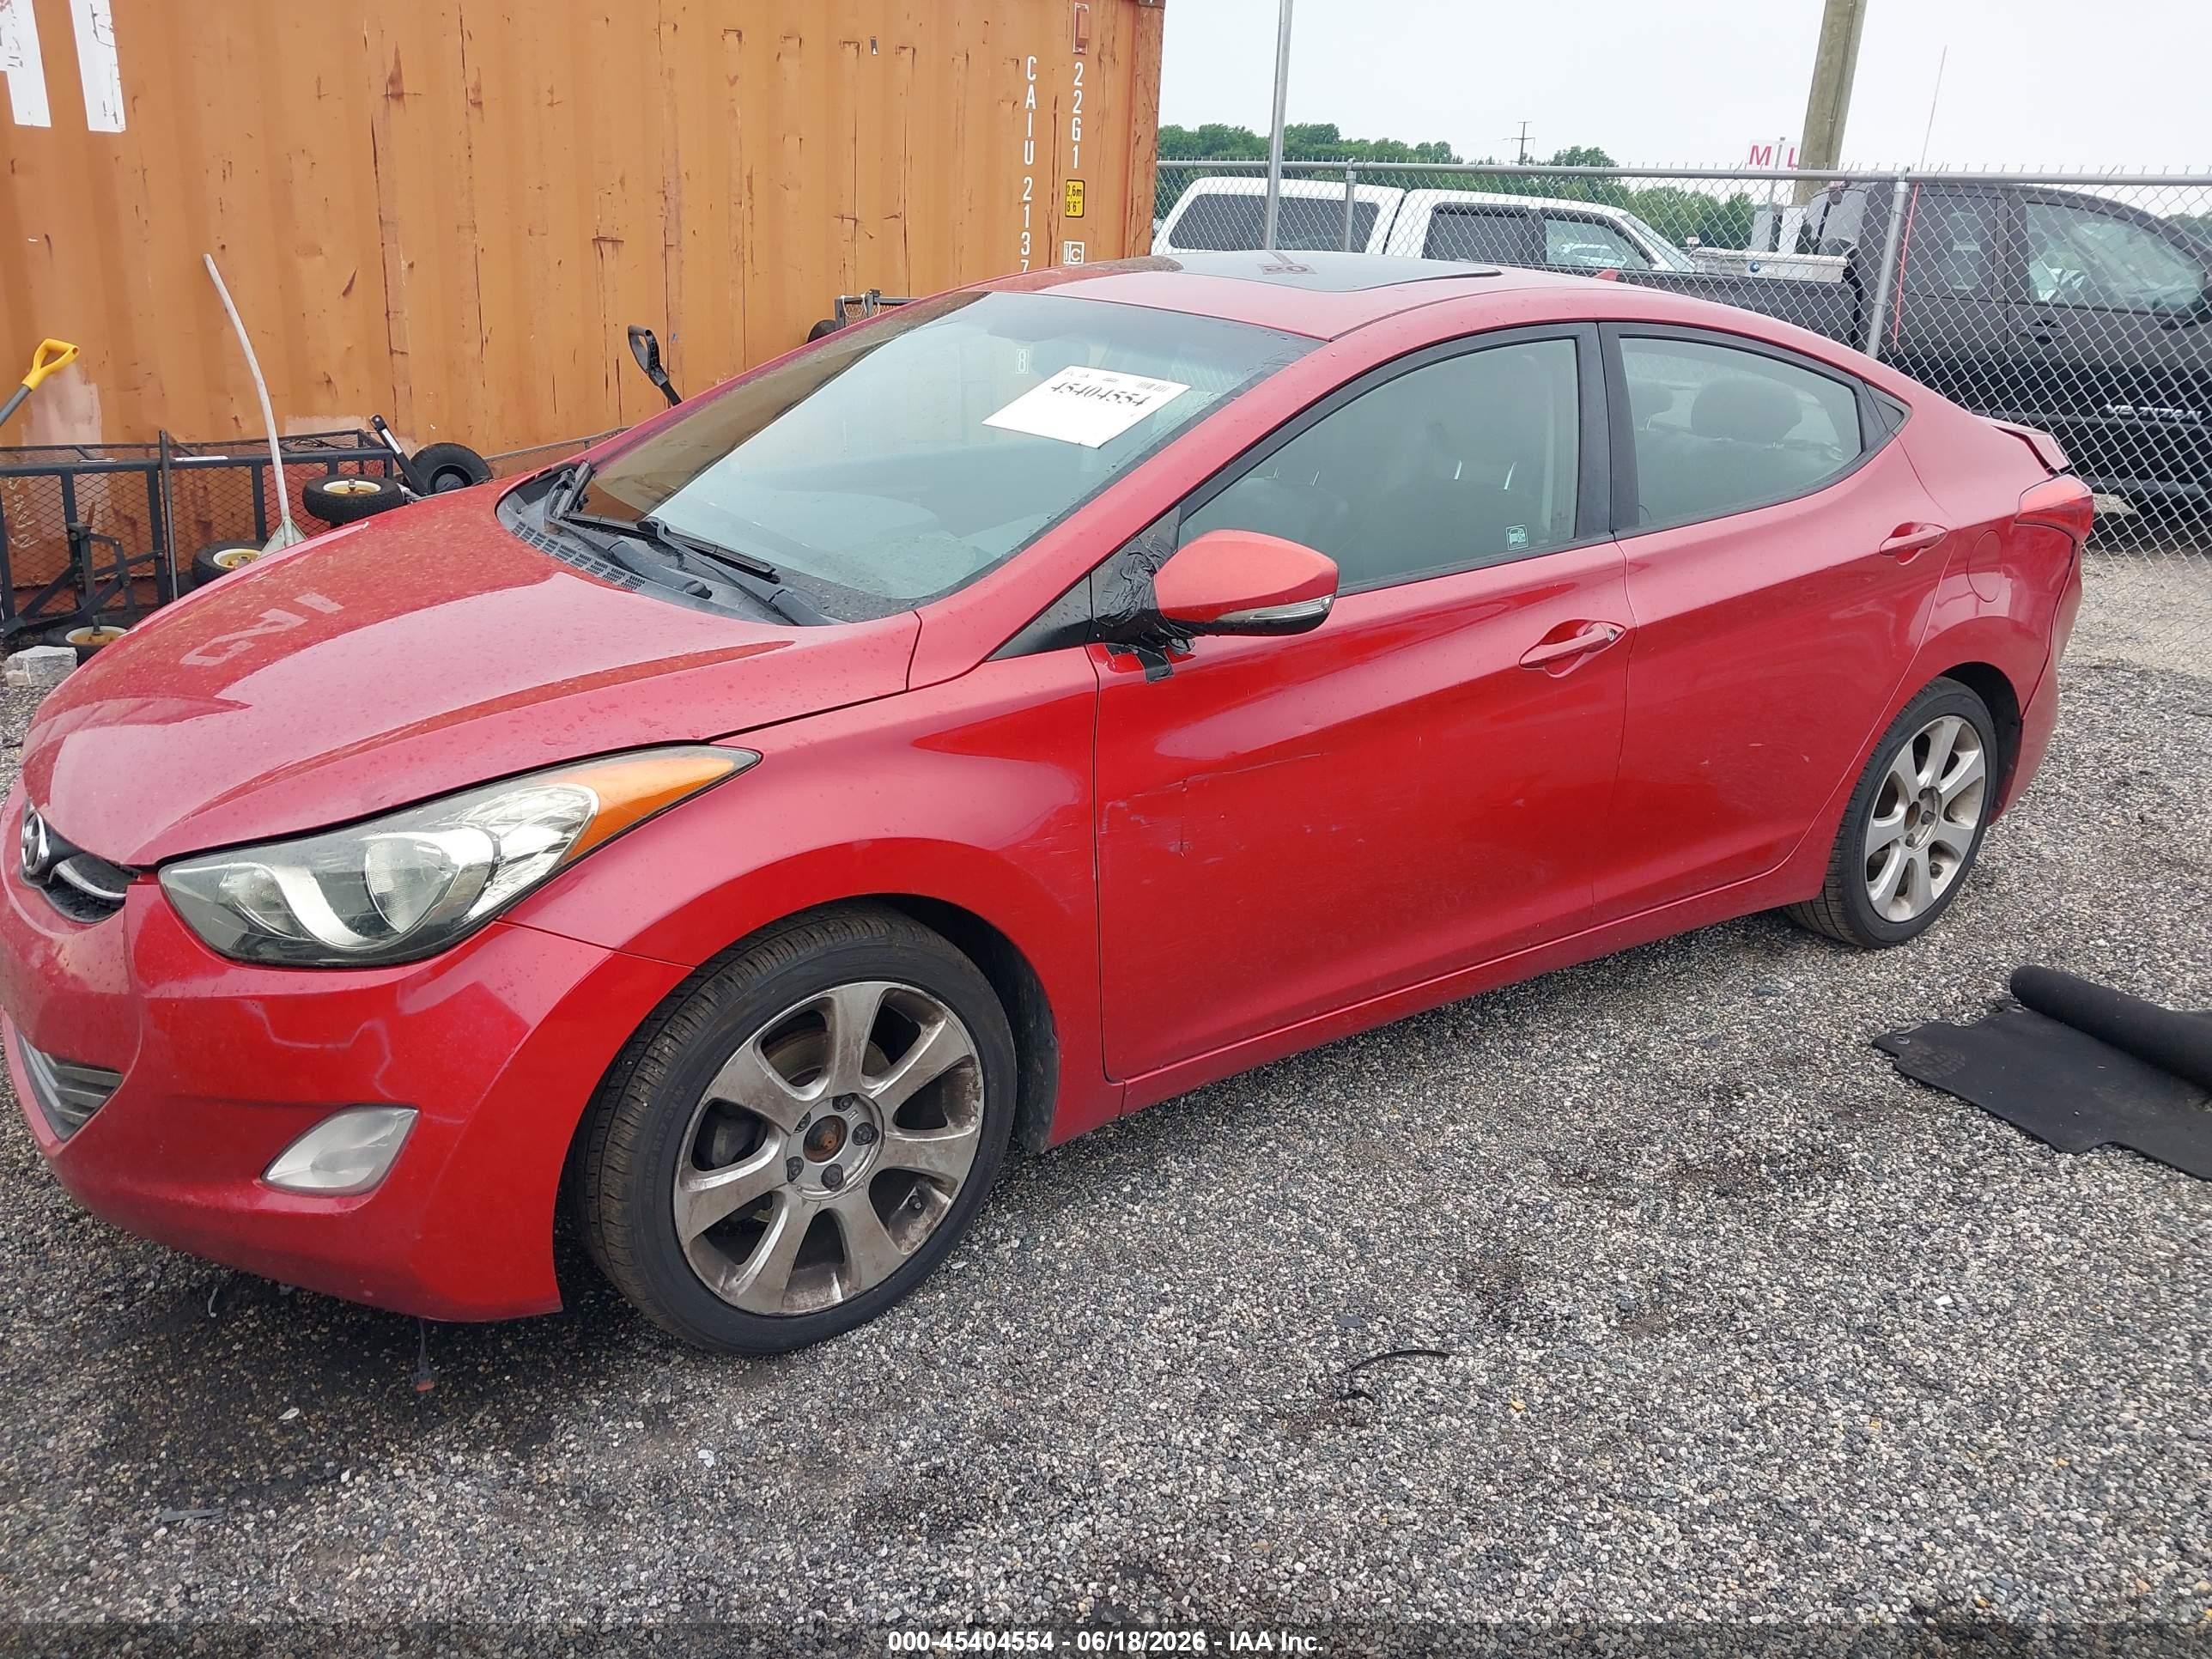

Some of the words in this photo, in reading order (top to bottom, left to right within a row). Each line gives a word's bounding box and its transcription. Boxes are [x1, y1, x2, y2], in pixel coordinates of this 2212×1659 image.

[1024, 55, 1036, 165] CAIU
[1072, 61, 1084, 169] 22G1
[1051, 381, 1152, 406] 45404554
